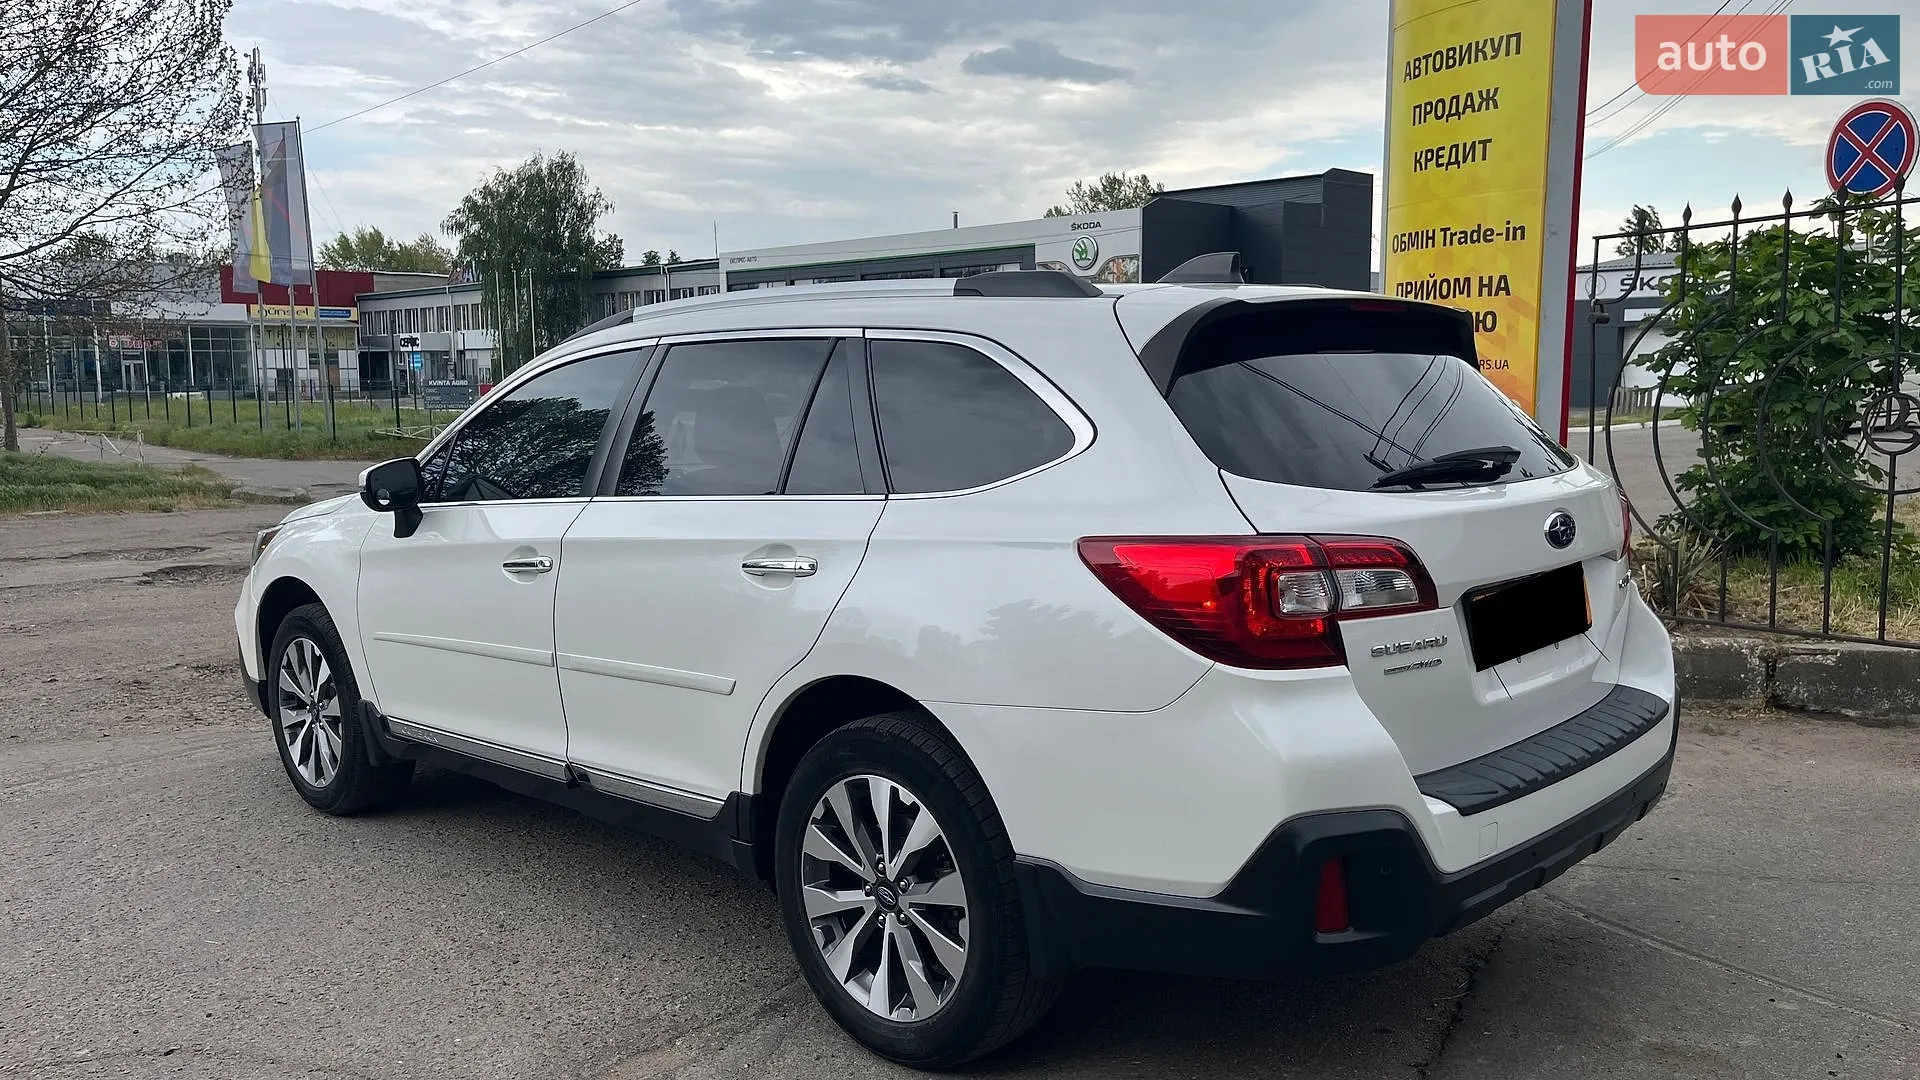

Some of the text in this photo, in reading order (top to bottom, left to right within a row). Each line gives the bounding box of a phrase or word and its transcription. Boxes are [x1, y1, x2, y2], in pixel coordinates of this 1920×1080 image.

[1403, 31, 1522, 83] АВТОВИКУП
[1412, 86, 1500, 127] ПРОДАЖ
[1413, 138, 1493, 173] КРЕДИТ
[1070, 221, 1102, 231] ŠKODA
[1392, 220, 1526, 254] ОБМІН Trade-in
[1396, 272, 1512, 301] ПРИЙОМ НА
[1370, 635, 1448, 657] SUBARU
